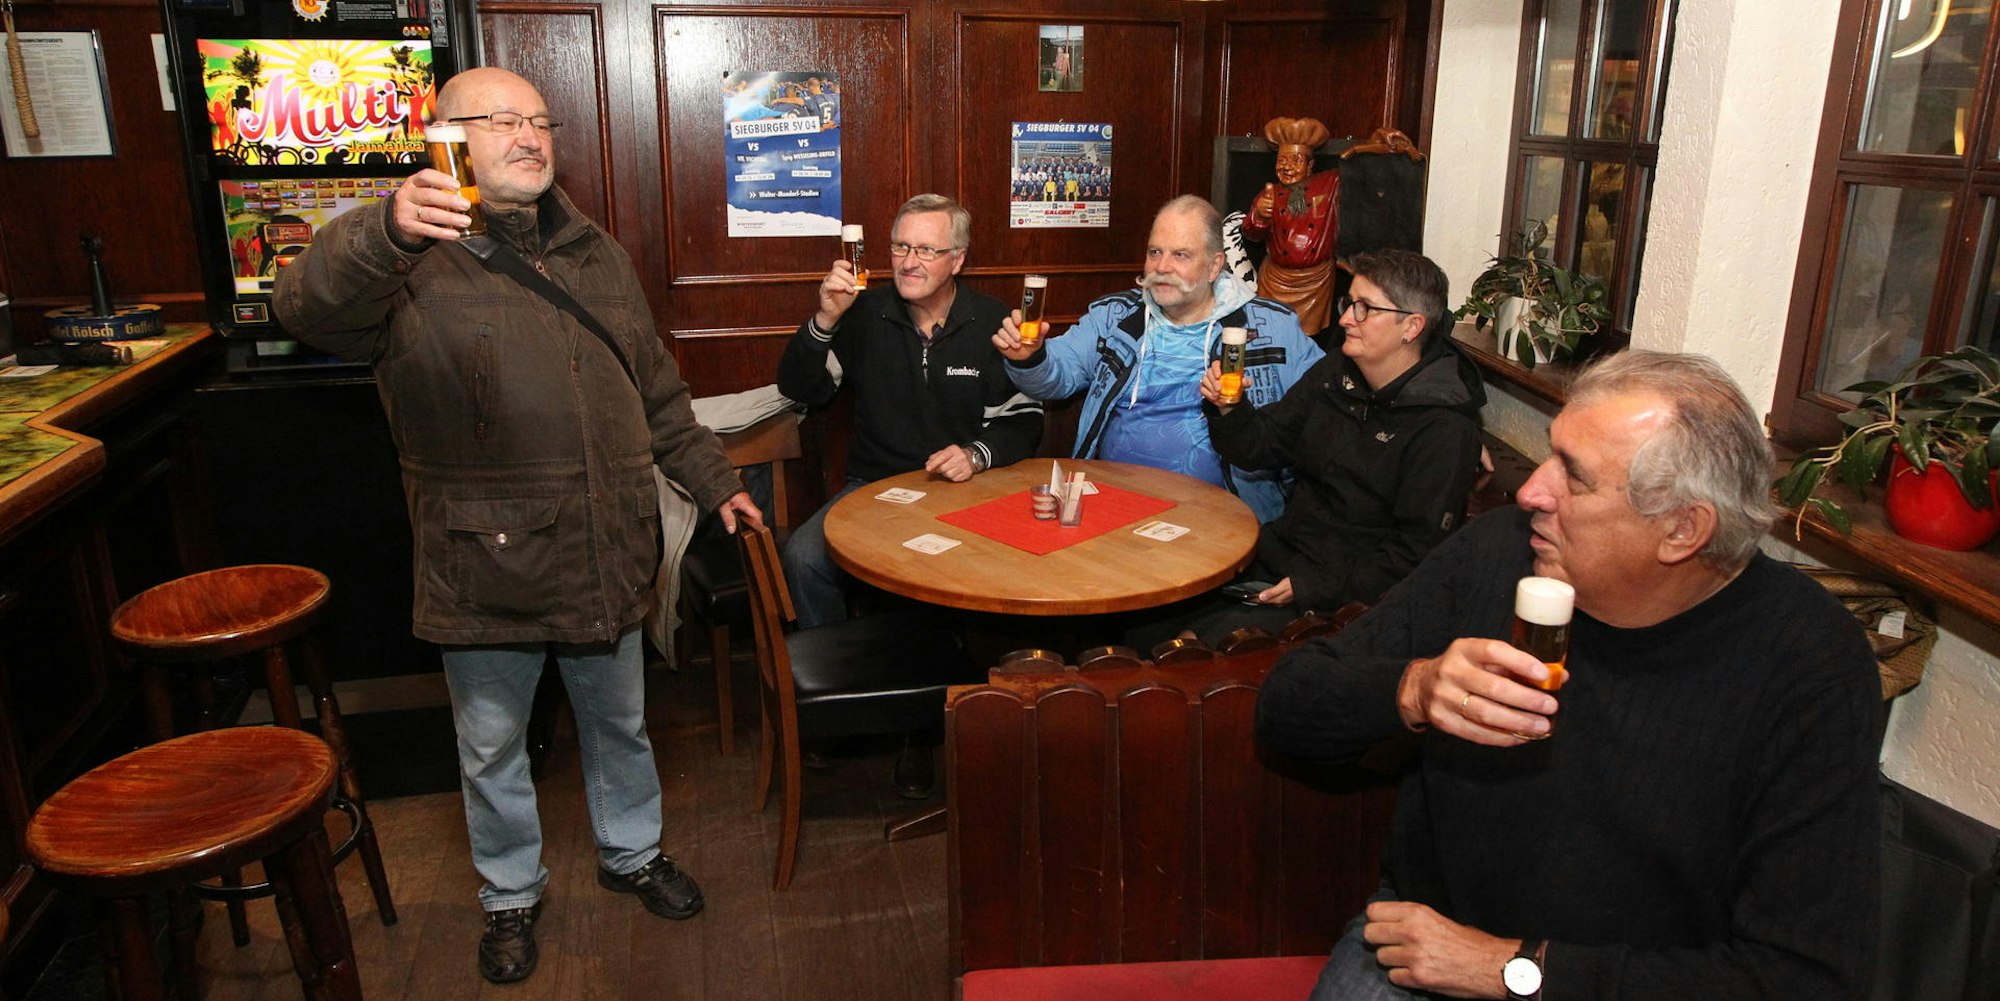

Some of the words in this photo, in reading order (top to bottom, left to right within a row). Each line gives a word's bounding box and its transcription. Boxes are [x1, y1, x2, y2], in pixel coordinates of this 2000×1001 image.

[237, 74, 404, 147] Multi
[734, 121, 790, 135] SIEGBURGER
[793, 121, 804, 131] SV
[805, 120, 816, 130] 04
[1026, 123, 1075, 132] SIEGBURGER
[1076, 124, 1087, 133] SV
[1088, 124, 1099, 133] 04
[348, 139, 425, 152] Jamaika
[748, 142, 759, 151] VS
[798, 139, 809, 148] VS
[73, 324, 114, 338] Kölsch
